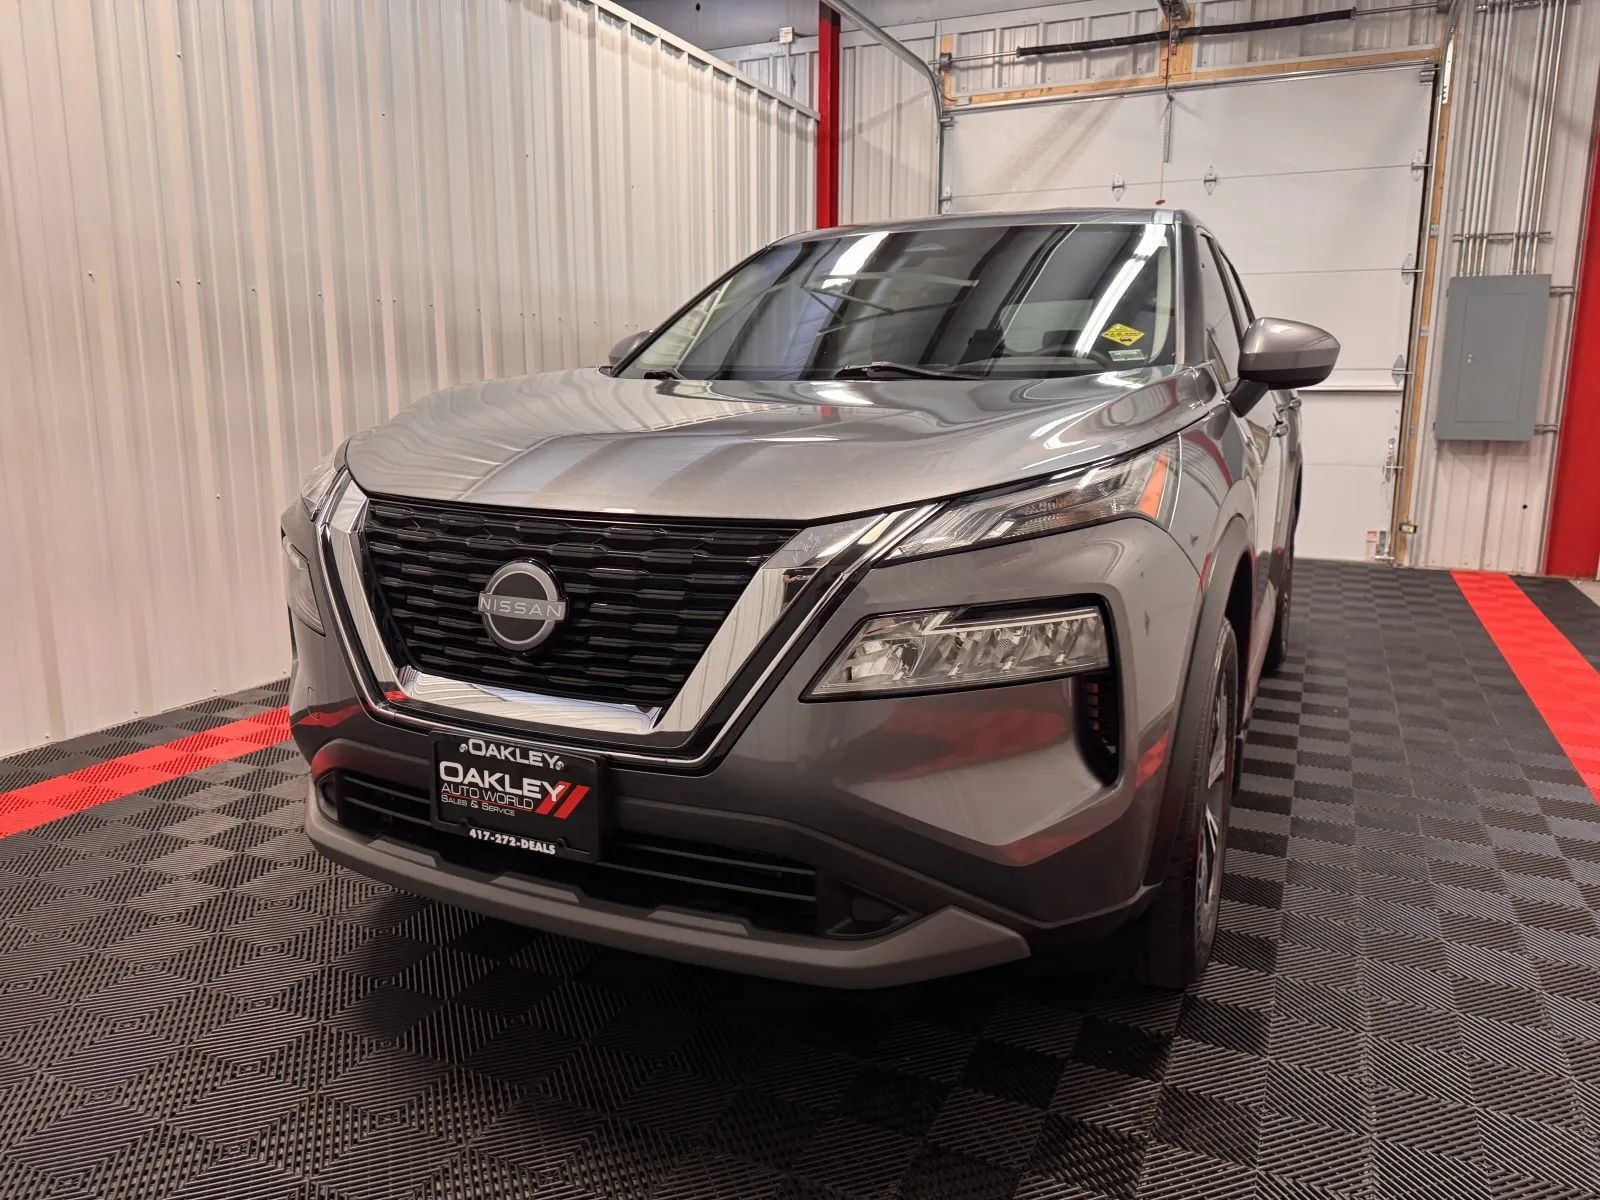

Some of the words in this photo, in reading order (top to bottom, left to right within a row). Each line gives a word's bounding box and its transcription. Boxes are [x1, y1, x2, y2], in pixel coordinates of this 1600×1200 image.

[480, 596, 562, 617] NISSAN
[468, 739, 559, 769] OAKLEY
[439, 761, 566, 802] OAKLEY
[441, 783, 479, 799] AUTO
[482, 790, 533, 810] WORLD
[441, 794, 468, 807] SALES
[471, 800, 479, 809] &
[481, 802, 515, 816] SERVICE
[469, 829, 556, 855] 417-272-DEALS
